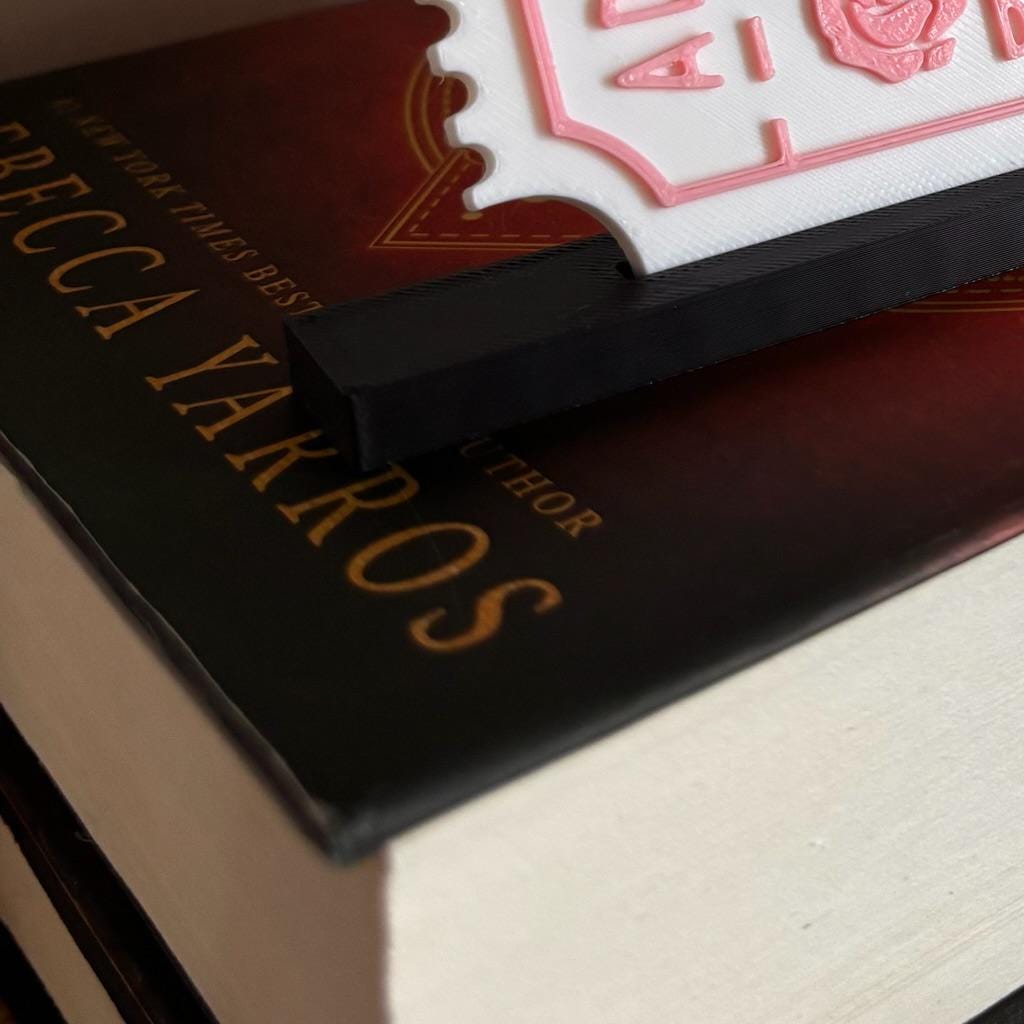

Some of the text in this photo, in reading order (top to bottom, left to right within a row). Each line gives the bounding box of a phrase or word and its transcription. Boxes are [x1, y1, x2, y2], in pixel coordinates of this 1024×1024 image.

[111, 148, 187, 199] YORK
[168, 201, 259, 262] TIMES
[145, 333, 563, 653] YAKROS
